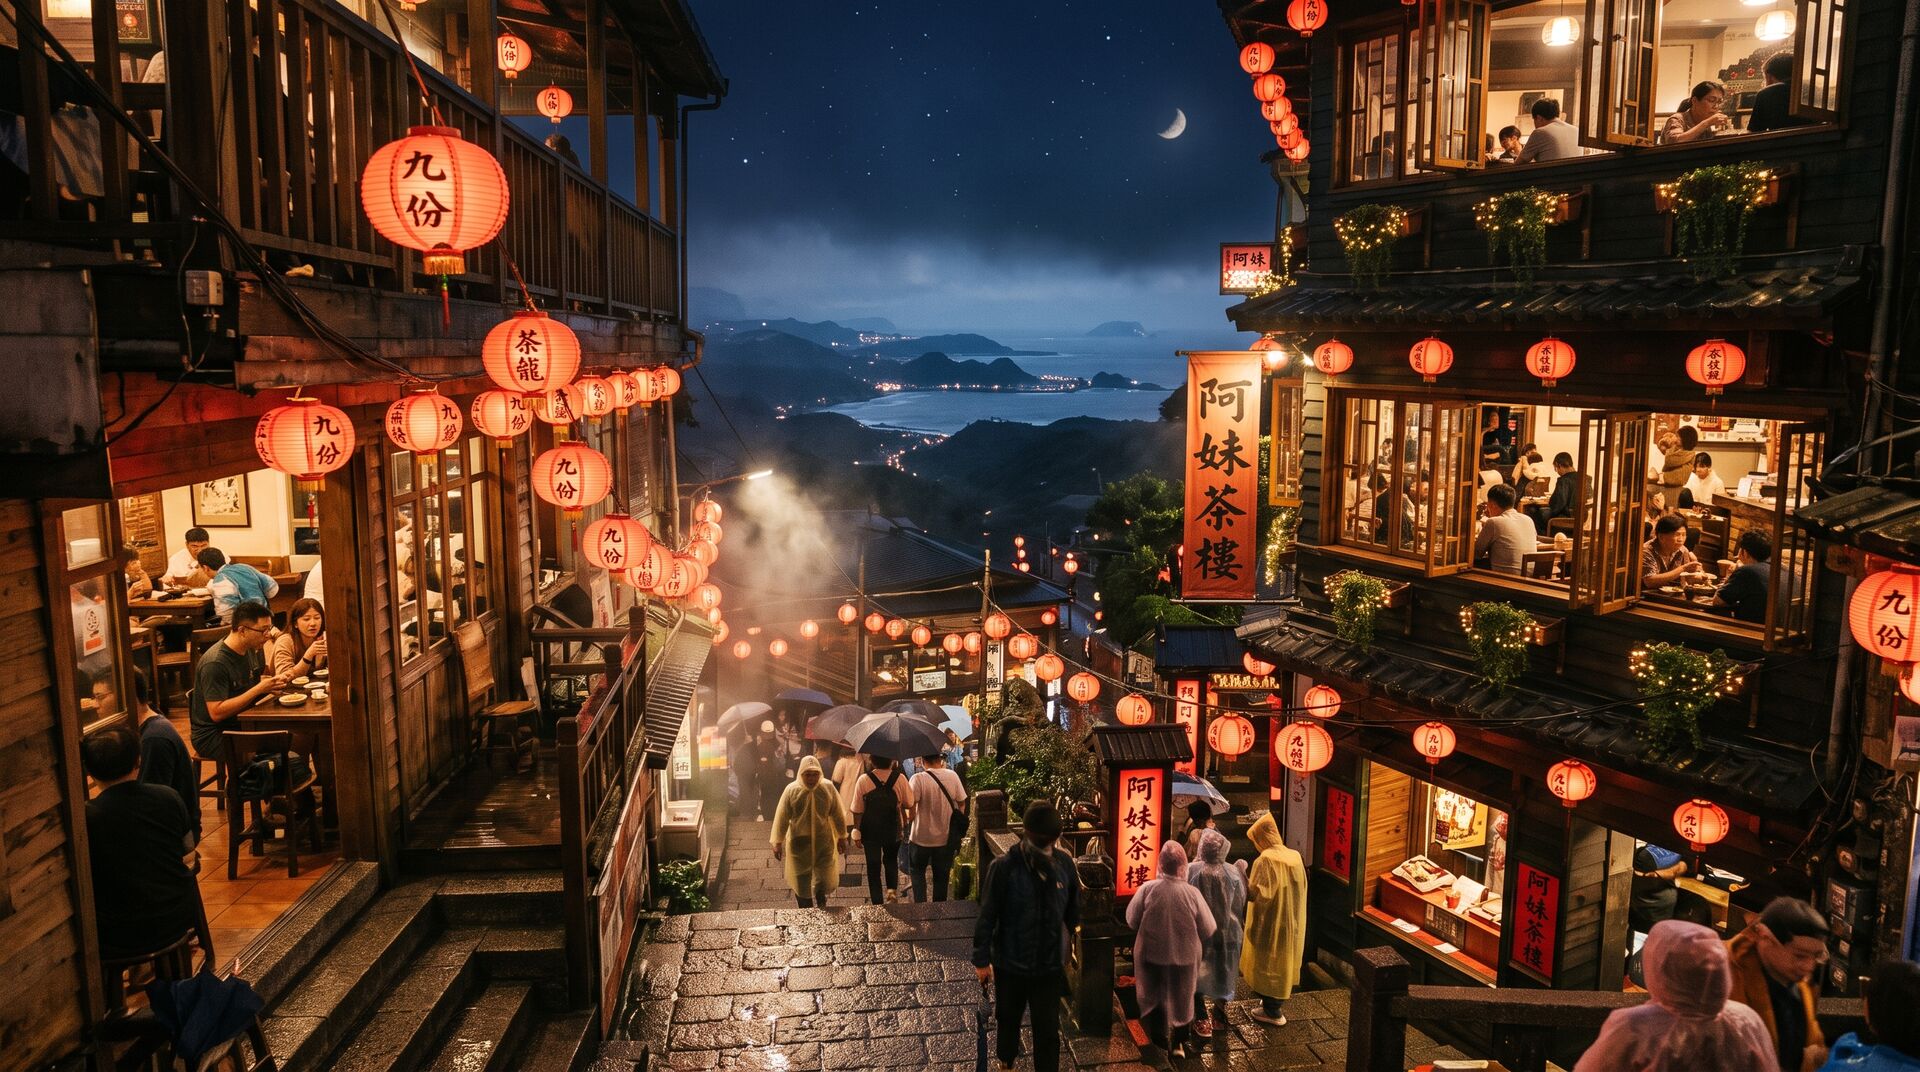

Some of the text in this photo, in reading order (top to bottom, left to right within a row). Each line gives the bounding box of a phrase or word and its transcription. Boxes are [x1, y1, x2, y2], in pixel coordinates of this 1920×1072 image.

[504, 40, 517, 61] 九份
[402, 150, 452, 228] 九份
[1233, 251, 1266, 267] 阿妹
[515, 329, 545, 382] 茶龍
[510, 397, 526, 430] 九份
[313, 415, 341, 465] 九份
[555, 458, 578, 499] 九份
[1193, 377, 1252, 581] 阿妹茶樓
[603, 528, 624, 564] 九份
[1876, 589, 1910, 649] 九份
[1123, 776, 1156, 889] 阿妹茶樓
[1522, 870, 1550, 969] 阿妹茶樓
